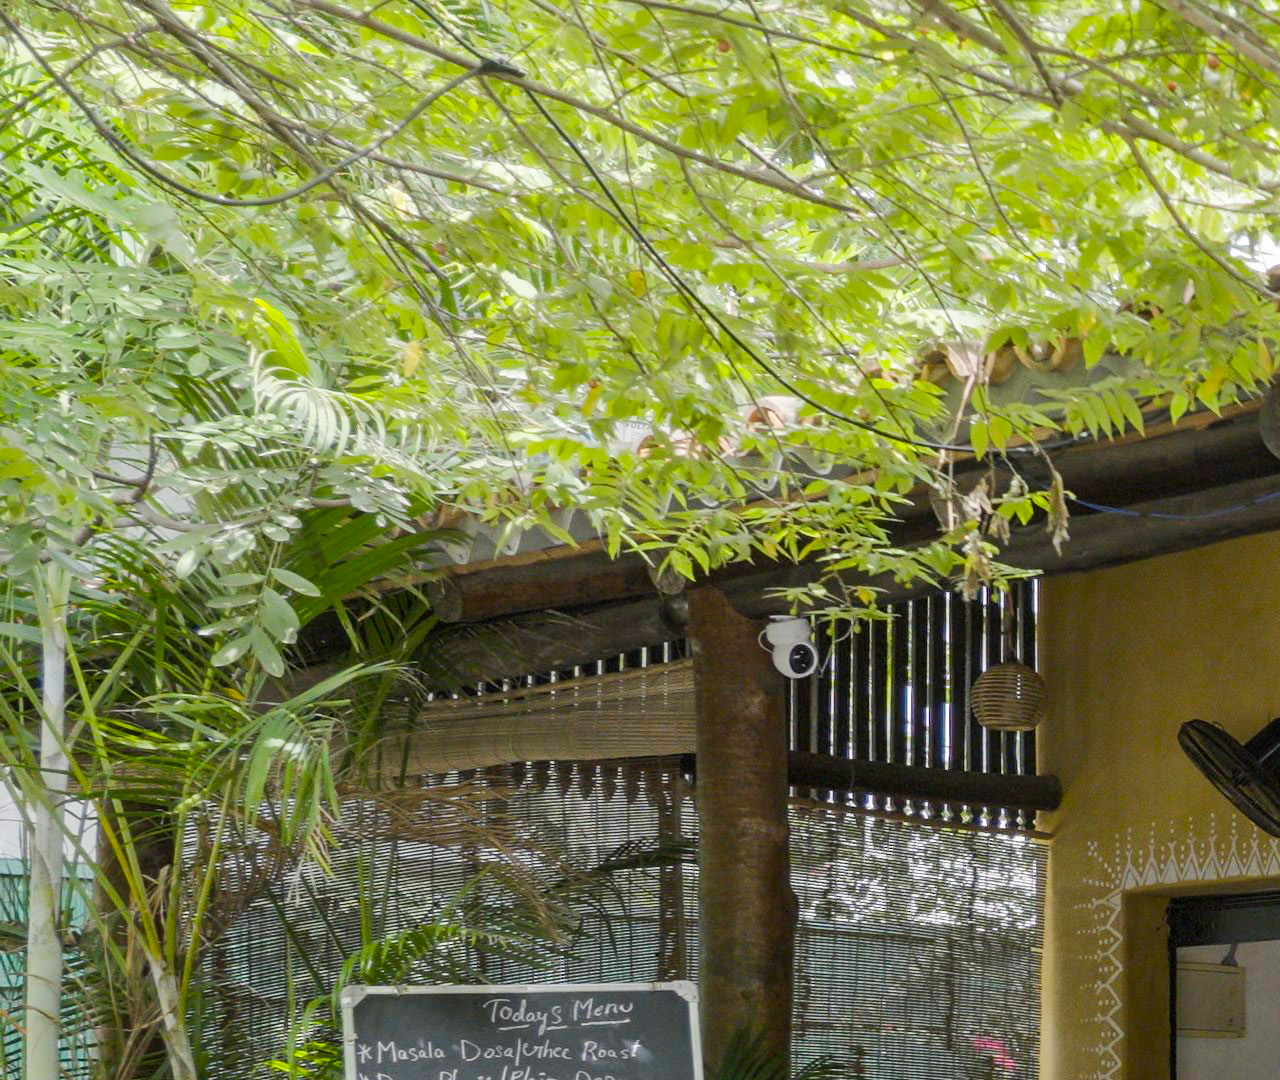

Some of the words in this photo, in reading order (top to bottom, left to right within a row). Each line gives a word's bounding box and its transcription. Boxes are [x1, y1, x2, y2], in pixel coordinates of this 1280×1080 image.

[573, 997, 633, 1022] Menu
[377, 1040, 446, 1064] Masala
[581, 1039, 642, 1062] Roast
